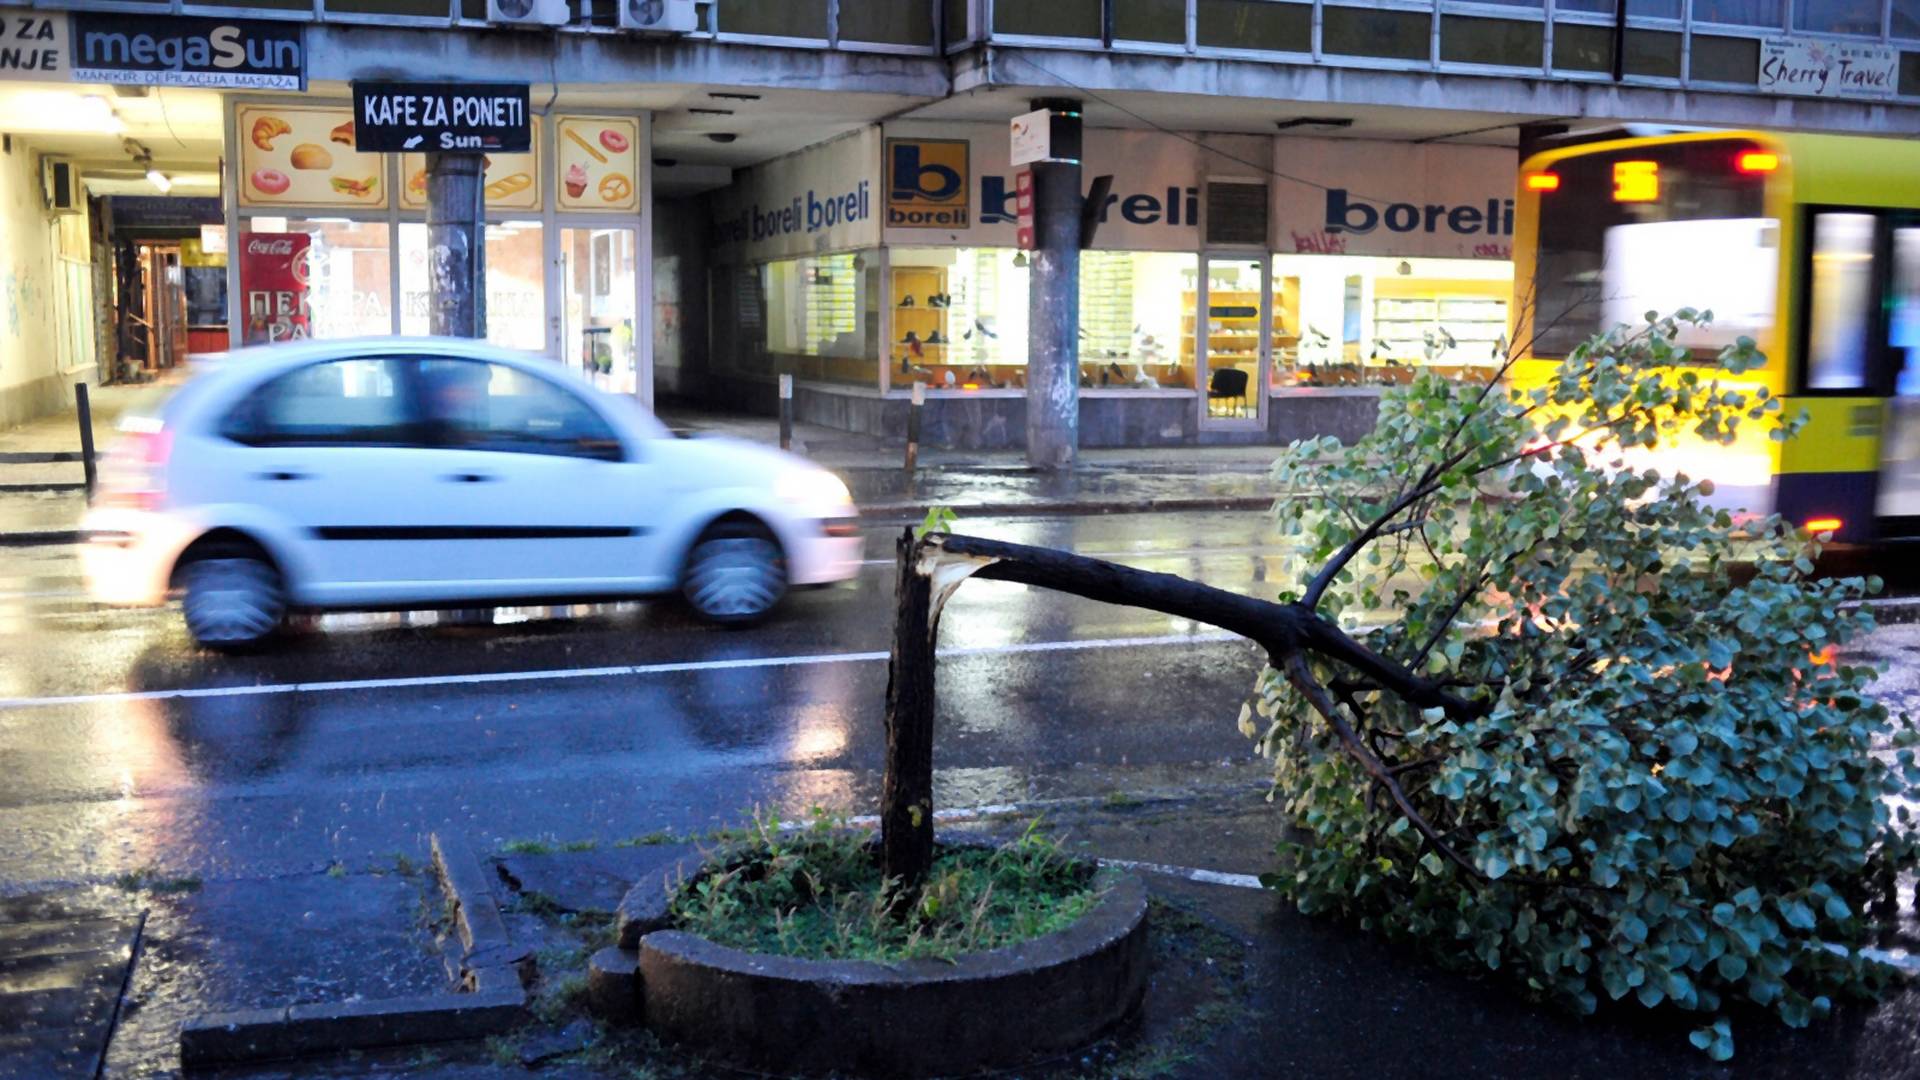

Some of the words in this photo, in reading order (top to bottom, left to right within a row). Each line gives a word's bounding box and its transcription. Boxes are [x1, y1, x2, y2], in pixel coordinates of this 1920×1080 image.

[16, 18, 54, 40] ZA
[85, 25, 299, 71] megaSun
[1763, 56, 1828, 94] Sherry
[1838, 60, 1895, 87] Travel
[364, 95, 418, 126] KAFE
[422, 96, 449, 127] ZA
[453, 96, 523, 127] PONETI
[440, 131, 482, 148] Sun
[752, 196, 803, 242] boreli
[807, 180, 868, 233] boreli
[889, 208, 967, 224] boreli
[980, 176, 1198, 226] breli
[1325, 189, 1515, 235] boreli
